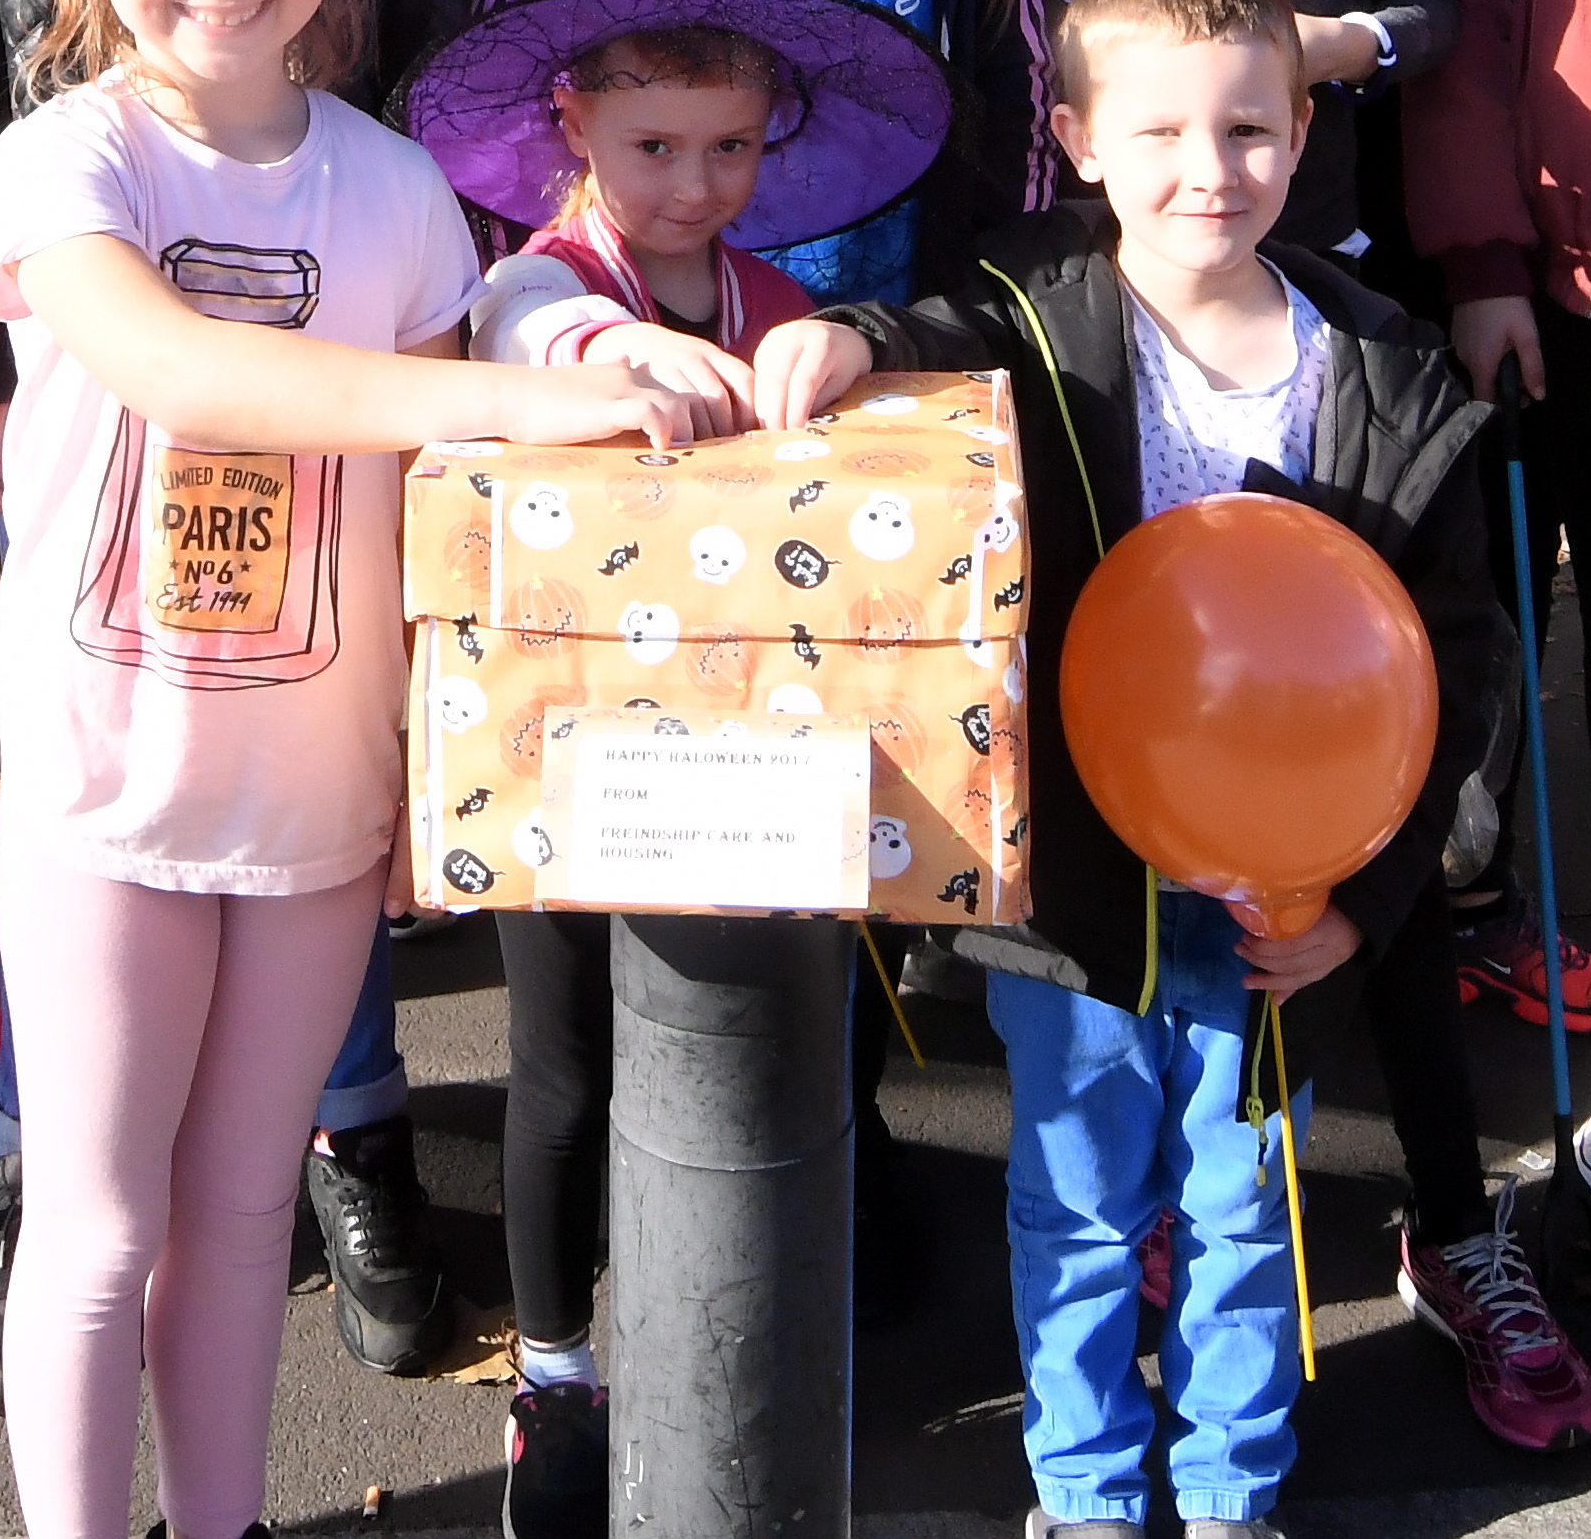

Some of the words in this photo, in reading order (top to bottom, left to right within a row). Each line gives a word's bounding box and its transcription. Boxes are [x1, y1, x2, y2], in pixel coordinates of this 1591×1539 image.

[160, 466, 214, 491] LIMITED
[222, 467, 285, 501] EDITION
[161, 502, 274, 552] PARIS
[156, 583, 204, 613] Est
[208, 590, 253, 614] 1994
[605, 749, 663, 762] HAPPY
[669, 750, 762, 765] HALOWEEN
[603, 787, 648, 800] FROM
[600, 826, 701, 841] FREINDSHIP
[707, 830, 753, 843] CARE
[761, 831, 796, 844] AND
[599, 847, 674, 860] HOUSING
